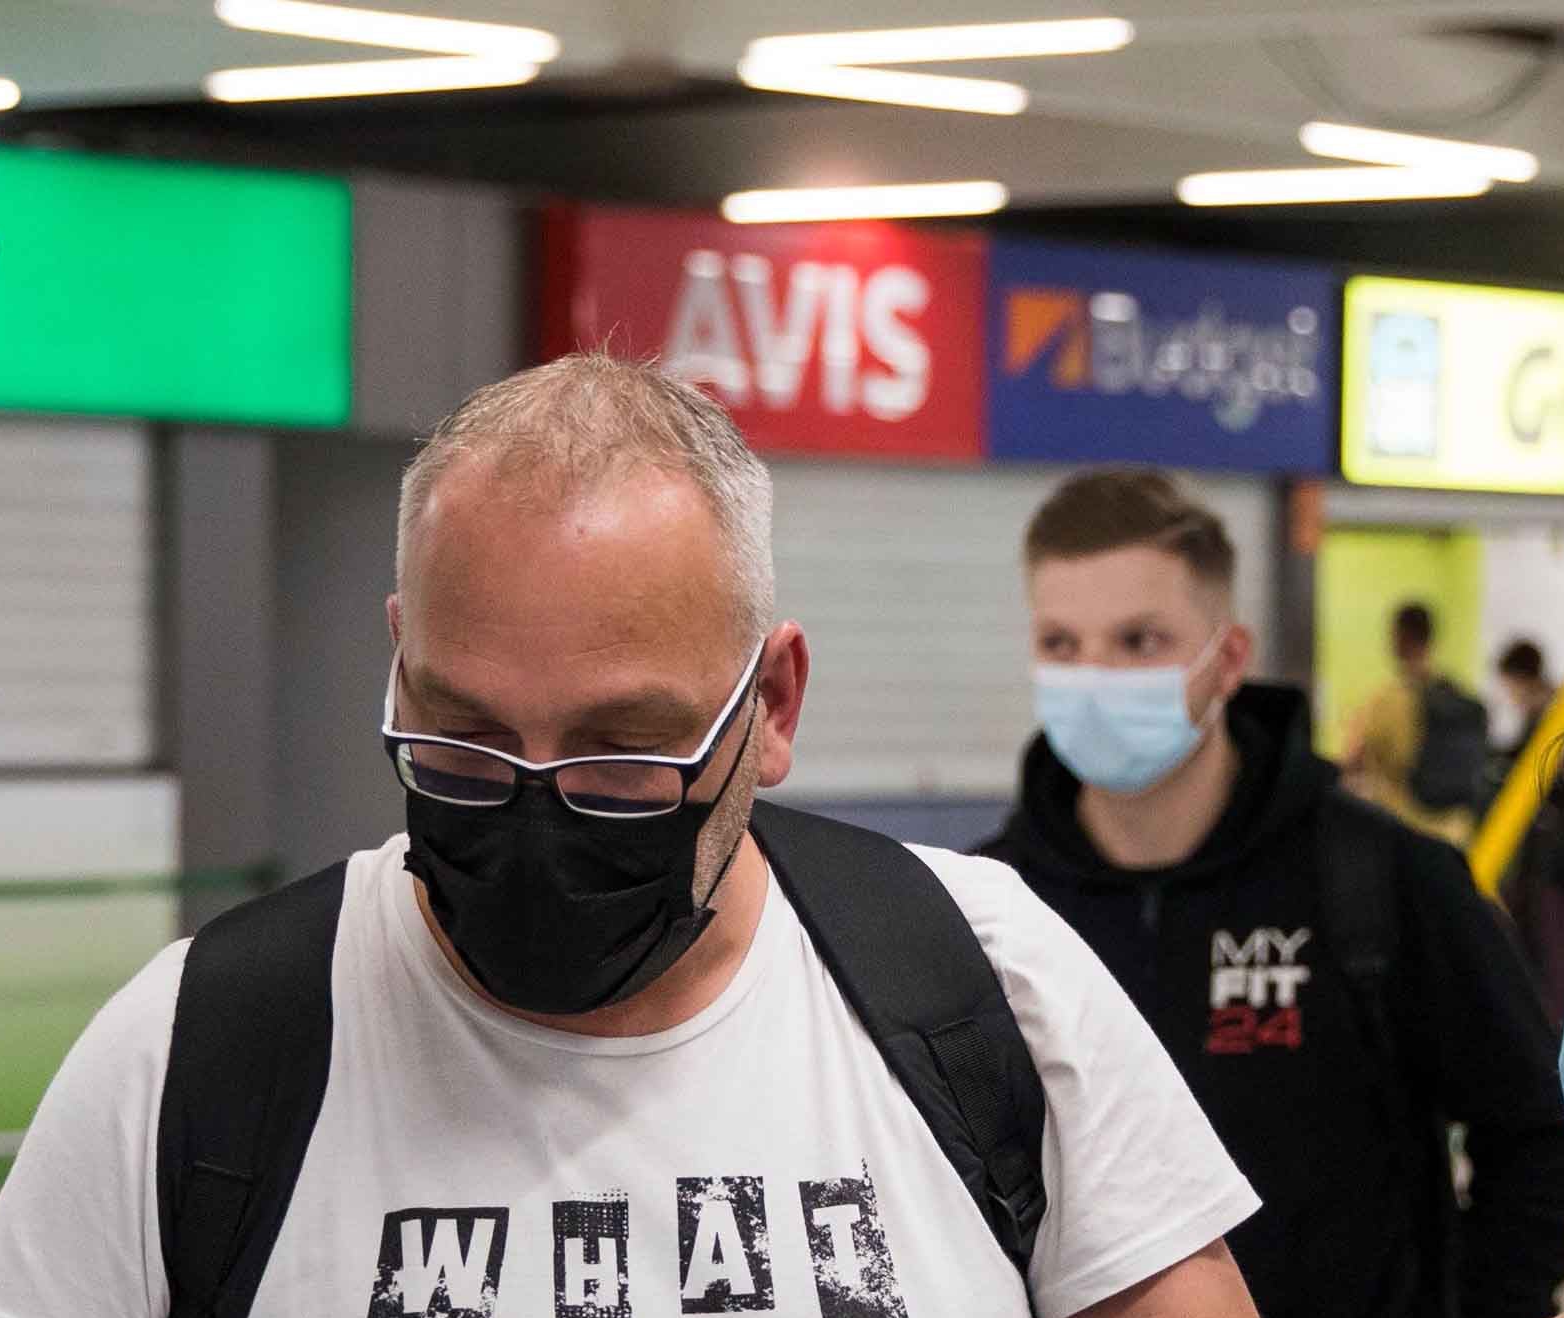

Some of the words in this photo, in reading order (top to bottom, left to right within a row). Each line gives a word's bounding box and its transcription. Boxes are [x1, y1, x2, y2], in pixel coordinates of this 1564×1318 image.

[663, 250, 932, 421] AVIS
[1210, 928, 1313, 967] MY
[1209, 964, 1313, 1009] FIT
[1205, 1004, 1302, 1056] 24
